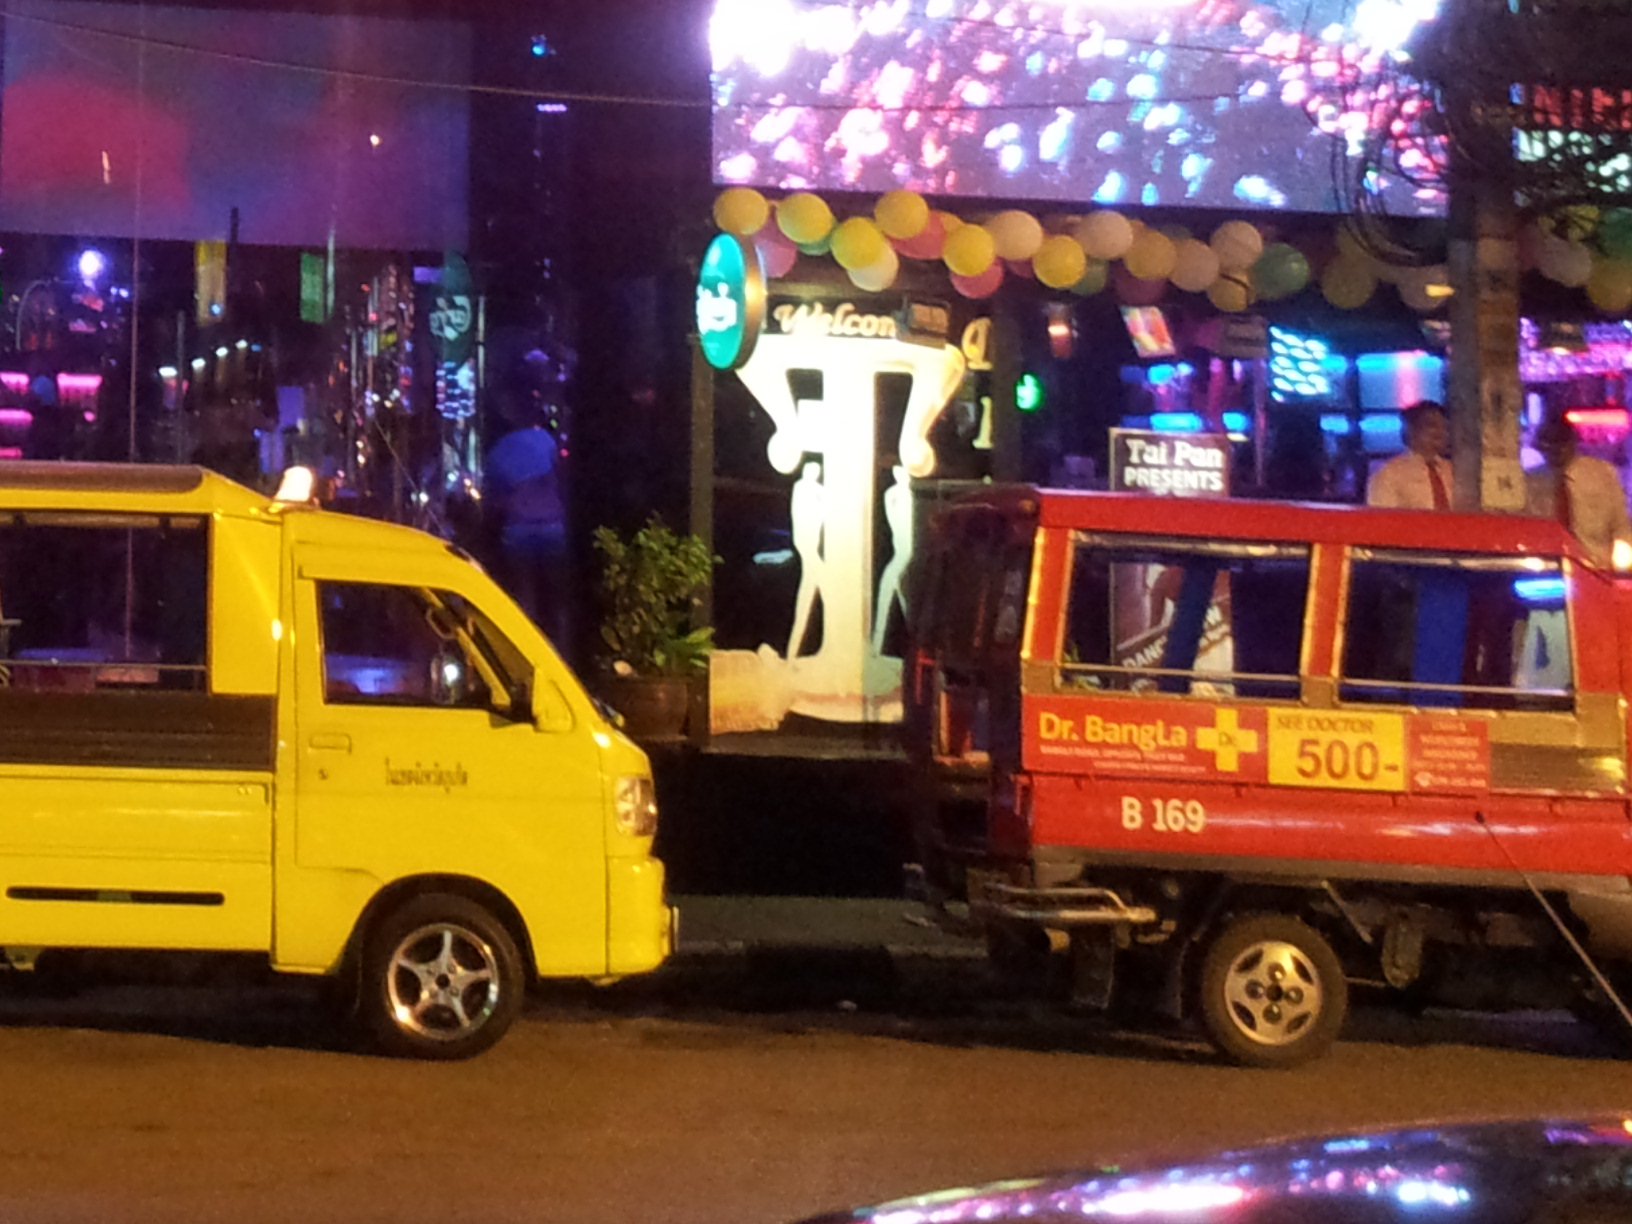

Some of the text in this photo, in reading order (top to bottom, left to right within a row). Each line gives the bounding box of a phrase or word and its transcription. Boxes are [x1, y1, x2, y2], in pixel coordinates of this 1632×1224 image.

[1125, 438, 1225, 468] Tai Pan
[1123, 465, 1225, 491] PRESENTS
[1039, 711, 1081, 742] Dr.
[1121, 794, 1208, 833] B 169
